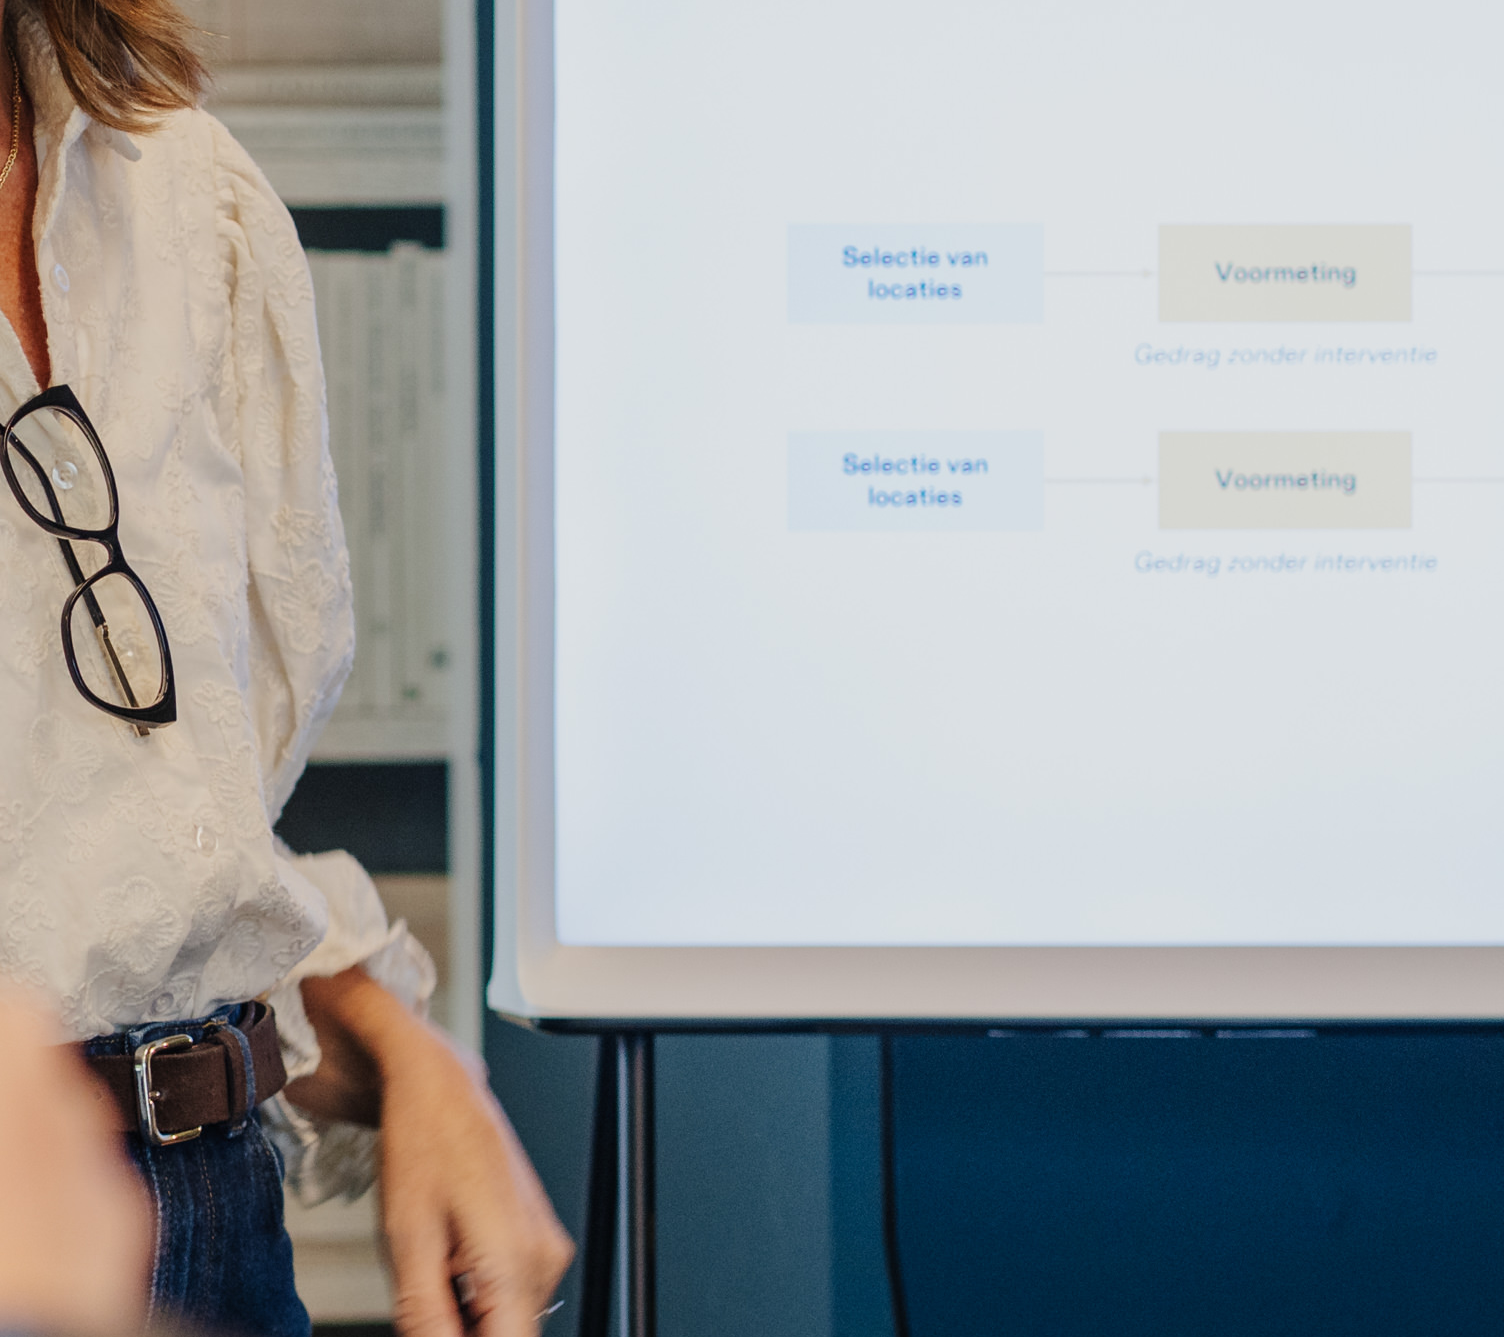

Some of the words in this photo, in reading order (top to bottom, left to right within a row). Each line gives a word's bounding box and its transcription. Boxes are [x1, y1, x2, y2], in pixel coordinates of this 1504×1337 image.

[842, 245, 941, 268] Selectie
[946, 252, 989, 267] van
[1214, 262, 1357, 289] Voormeting
[868, 280, 962, 299] locaties
[1134, 343, 1222, 369] Gedrag
[1227, 345, 1307, 365] zonder
[1314, 346, 1438, 364] interventie
[842, 453, 941, 475] Selectie
[947, 459, 989, 474] van
[1214, 469, 1357, 496] Voormeting
[868, 487, 963, 507] locaties
[1134, 550, 1222, 577] Gedrag
[1227, 552, 1308, 573] zonder
[1314, 553, 1438, 572] interventie
